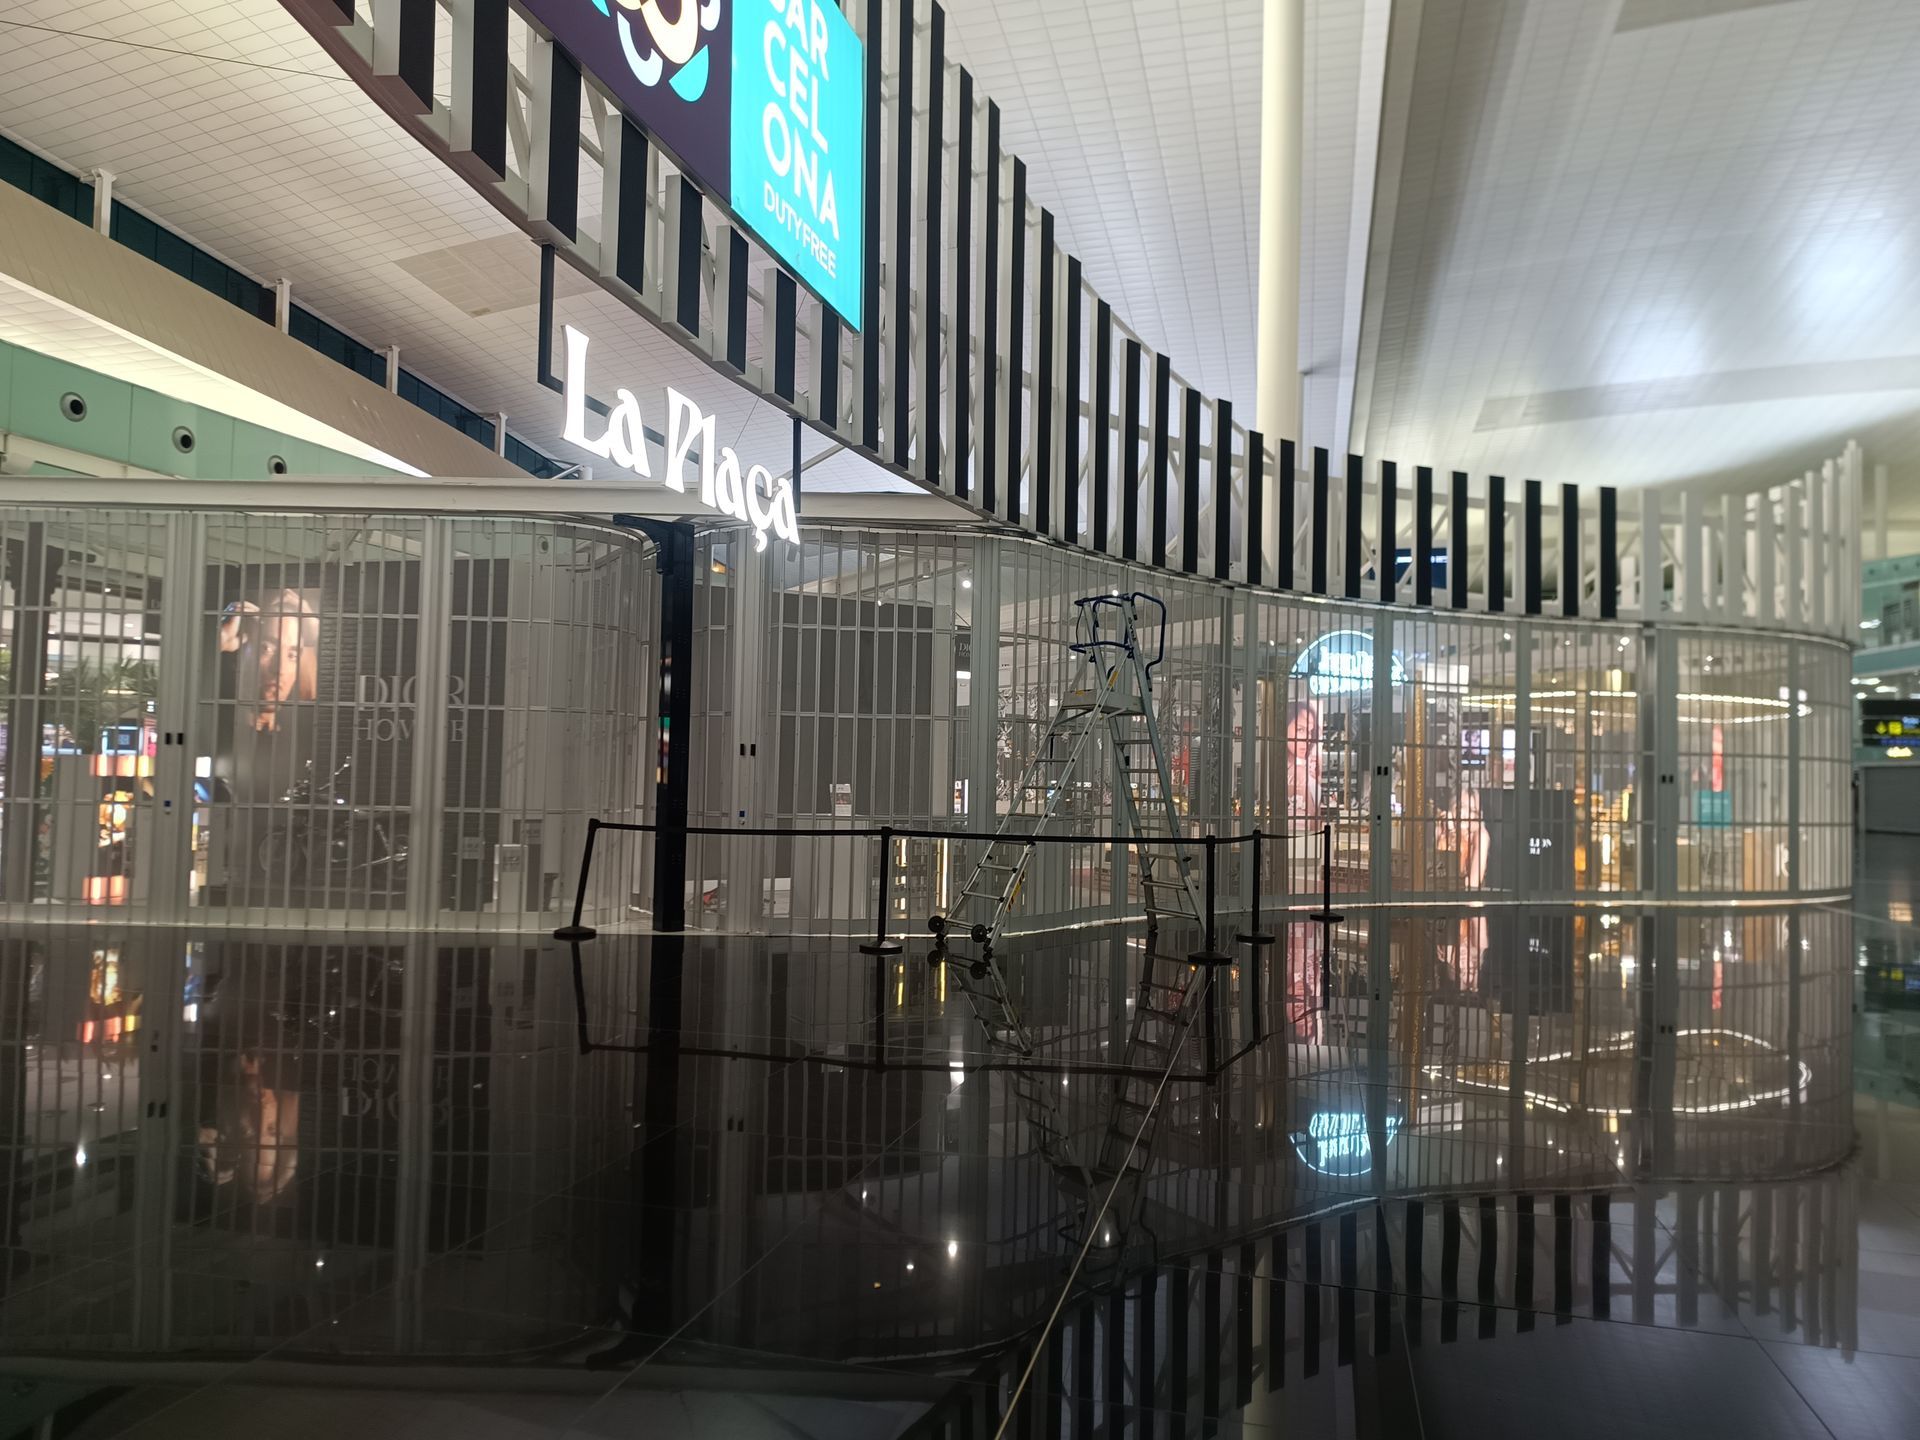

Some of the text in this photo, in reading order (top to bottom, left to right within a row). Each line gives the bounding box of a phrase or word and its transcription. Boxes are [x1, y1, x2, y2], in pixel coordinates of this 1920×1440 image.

[763, 19, 829, 155] CEL
[769, 0, 830, 81] AR
[762, 101, 840, 241] ONA
[561, 323, 652, 478] La
[355, 718, 466, 742] HOME
